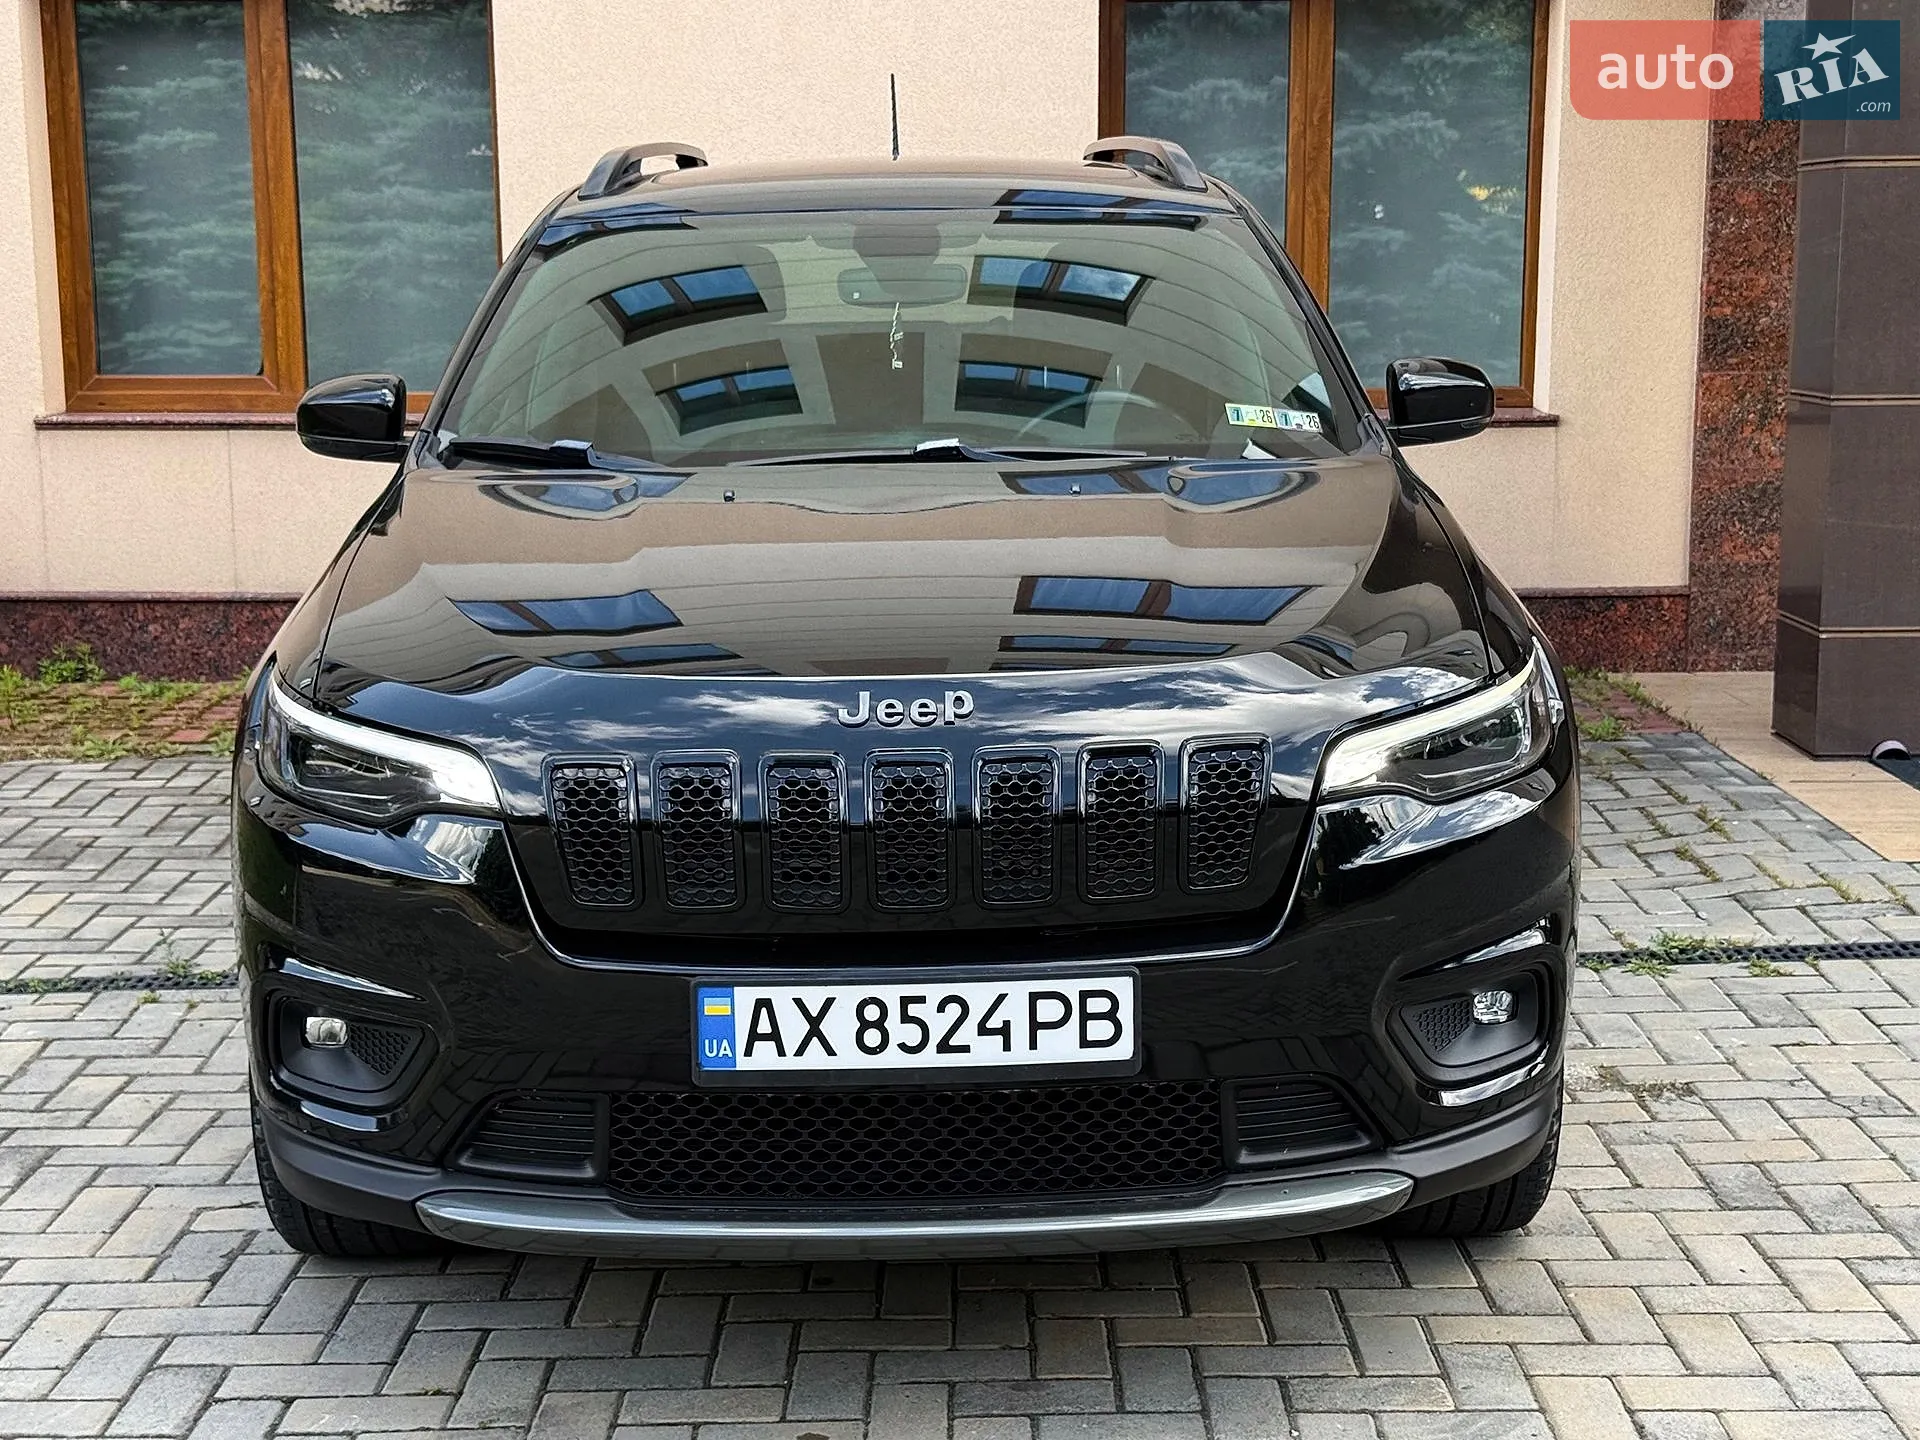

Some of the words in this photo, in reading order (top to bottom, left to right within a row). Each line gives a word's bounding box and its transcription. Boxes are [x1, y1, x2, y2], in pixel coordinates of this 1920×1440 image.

[1259, 409, 1273, 424] 26
[1306, 414, 1320, 429] 26
[837, 690, 975, 728] Jeep
[743, 996, 838, 1058] AX
[855, 993, 1012, 1056] 8524
[1029, 988, 1123, 1051] PB
[704, 1038, 733, 1058] UA
